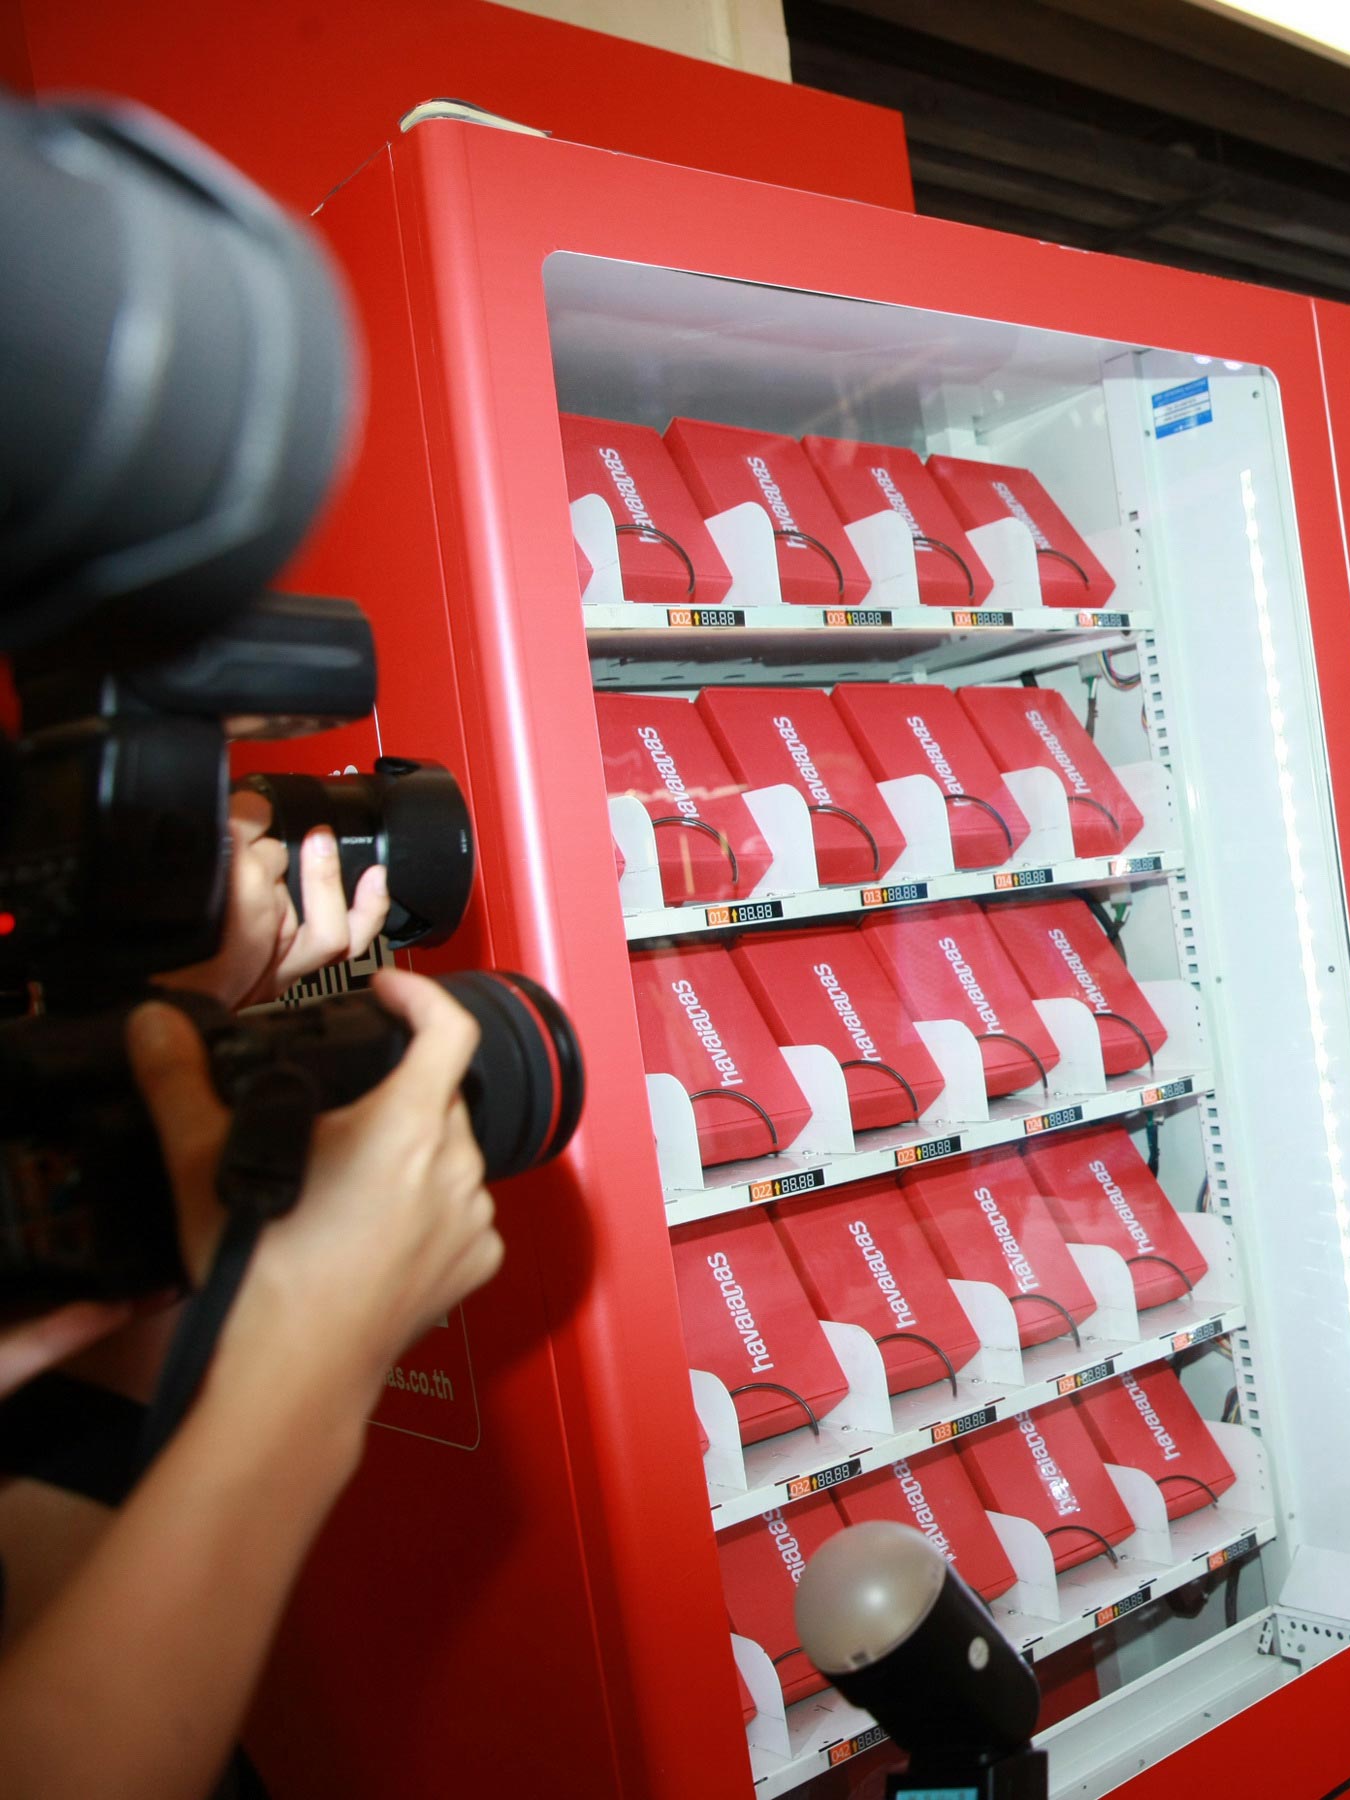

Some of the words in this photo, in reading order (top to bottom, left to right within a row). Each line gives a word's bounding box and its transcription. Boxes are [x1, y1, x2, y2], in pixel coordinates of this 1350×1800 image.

[671, 613, 691, 624] 002
[701, 611, 735, 626] 88.88
[827, 614, 846, 625] 003
[852, 612, 881, 625] 88.88
[1025, 709, 1092, 795] havaianas
[709, 913, 729, 924] 012
[739, 904, 773, 921] 88.88
[864, 891, 881, 902] 013
[888, 886, 917, 901] 88.88
[1019, 870, 1045, 884] 88.88
[814, 963, 882, 1063] havaianas
[939, 937, 1005, 1035] havaianas
[1049, 928, 1112, 1014] havaianas
[672, 979, 743, 1087] havaianas
[752, 1185, 772, 1200] 022
[782, 1174, 814, 1193] 88.88
[898, 1151, 915, 1163] 023
[922, 1140, 950, 1159] 88.88
[974, 1187, 1039, 1293] havaianas
[1089, 1160, 1155, 1255] havaianas
[707, 1252, 774, 1374] havaianas
[849, 1220, 917, 1329] havaianas
[934, 1426, 951, 1440] 033
[958, 1412, 985, 1431] 88.88
[1122, 1373, 1181, 1461] havaiana
[791, 1480, 810, 1496] 032
[818, 1464, 849, 1487] 88.88
